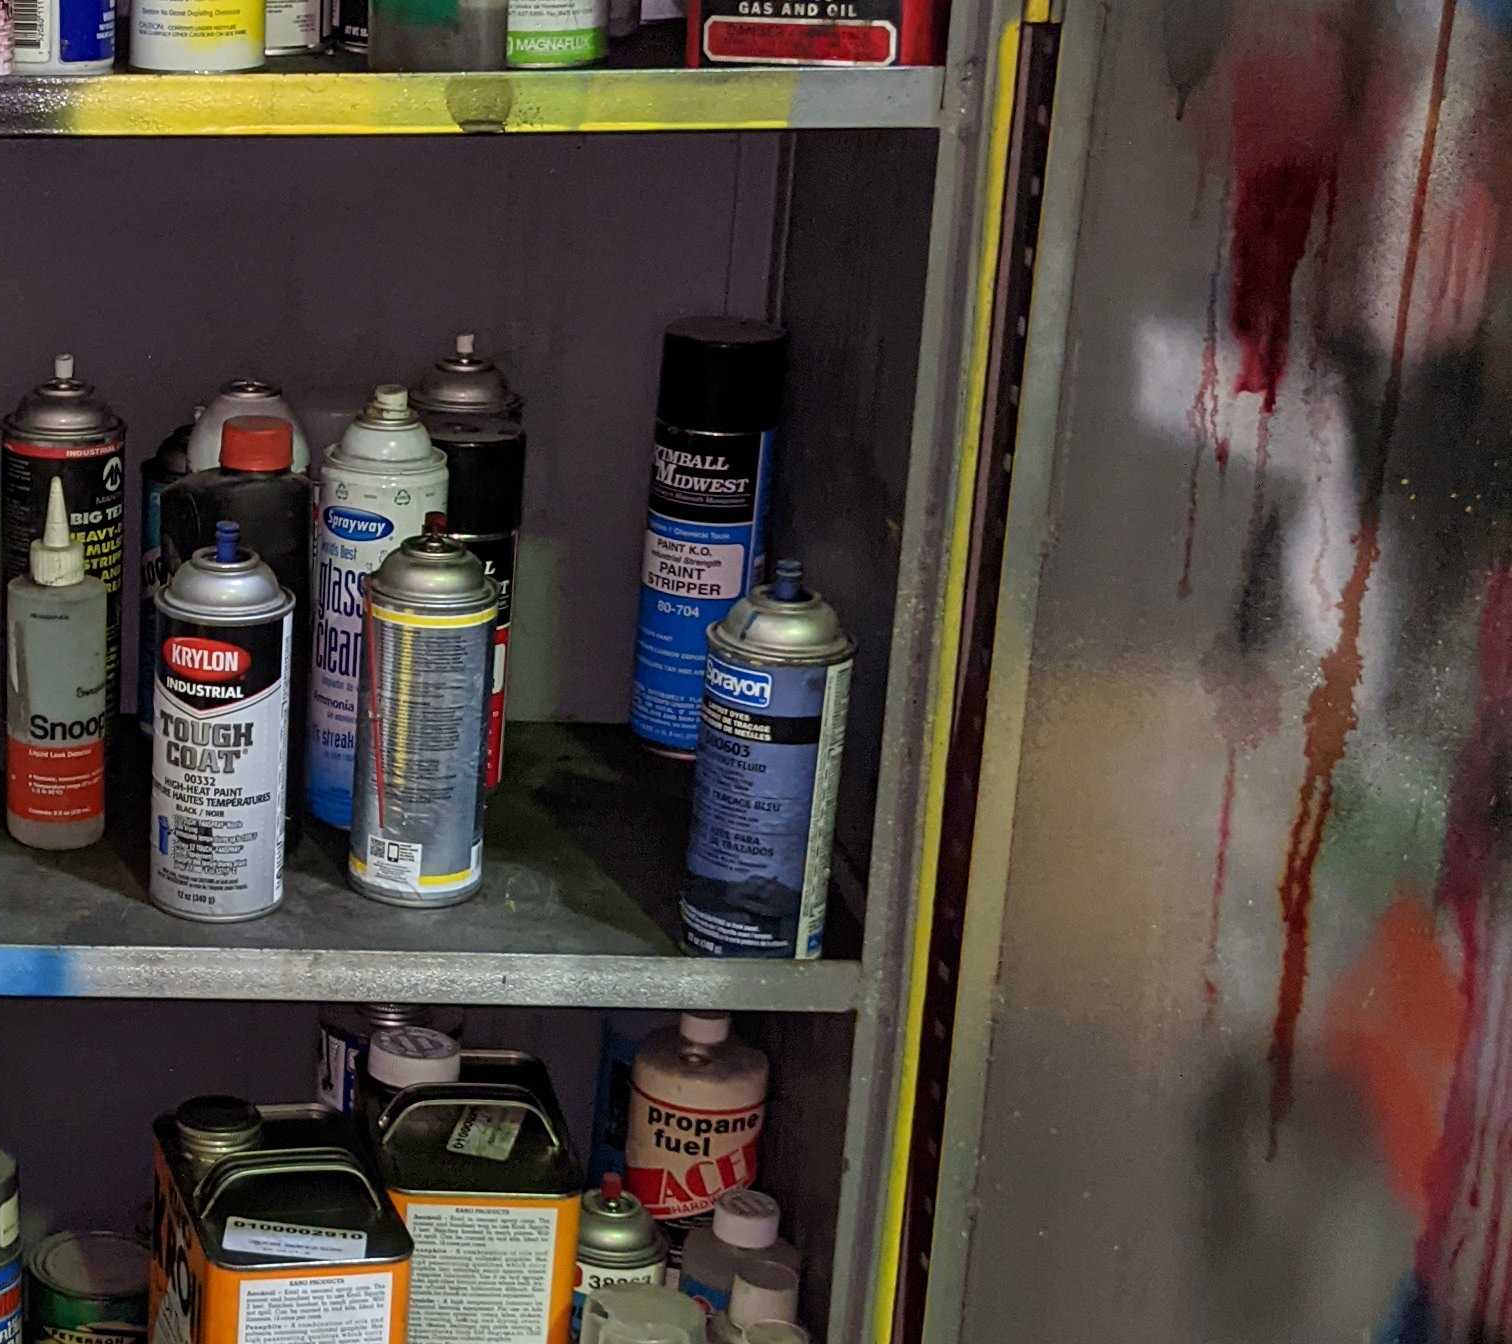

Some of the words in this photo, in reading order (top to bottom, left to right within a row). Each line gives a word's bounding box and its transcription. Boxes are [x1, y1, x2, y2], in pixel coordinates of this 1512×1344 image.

[739, 1, 773, 15] GAS
[782, 3, 818, 16] AND
[827, 4, 857, 18] OIL
[655, 461, 750, 494] MIDWEST
[70, 513, 103, 526] BIG
[328, 508, 386, 537] Sprayway
[657, 538, 685, 554] PAINT
[688, 544, 712, 557] K.O.
[659, 560, 706, 582] PAINT
[647, 570, 722, 597] STRIPPER
[657, 599, 700, 619] 80-704
[171, 643, 239, 672] KRYLON
[167, 676, 245, 699] INDUSTRIAL
[160, 709, 255, 748] TOUGH
[166, 740, 241, 775] COAT
[164, 775, 212, 797] HIGH-HEAT
[214, 787, 244, 797] PAINT
[184, 772, 217, 787] 00332
[176, 804, 198, 816] BLACK
[205, 809, 225, 818] NOIR
[648, 1105, 760, 1136] propane
[654, 1129, 711, 1157] fuel
[233, 1219, 364, 1241] 0100002910
